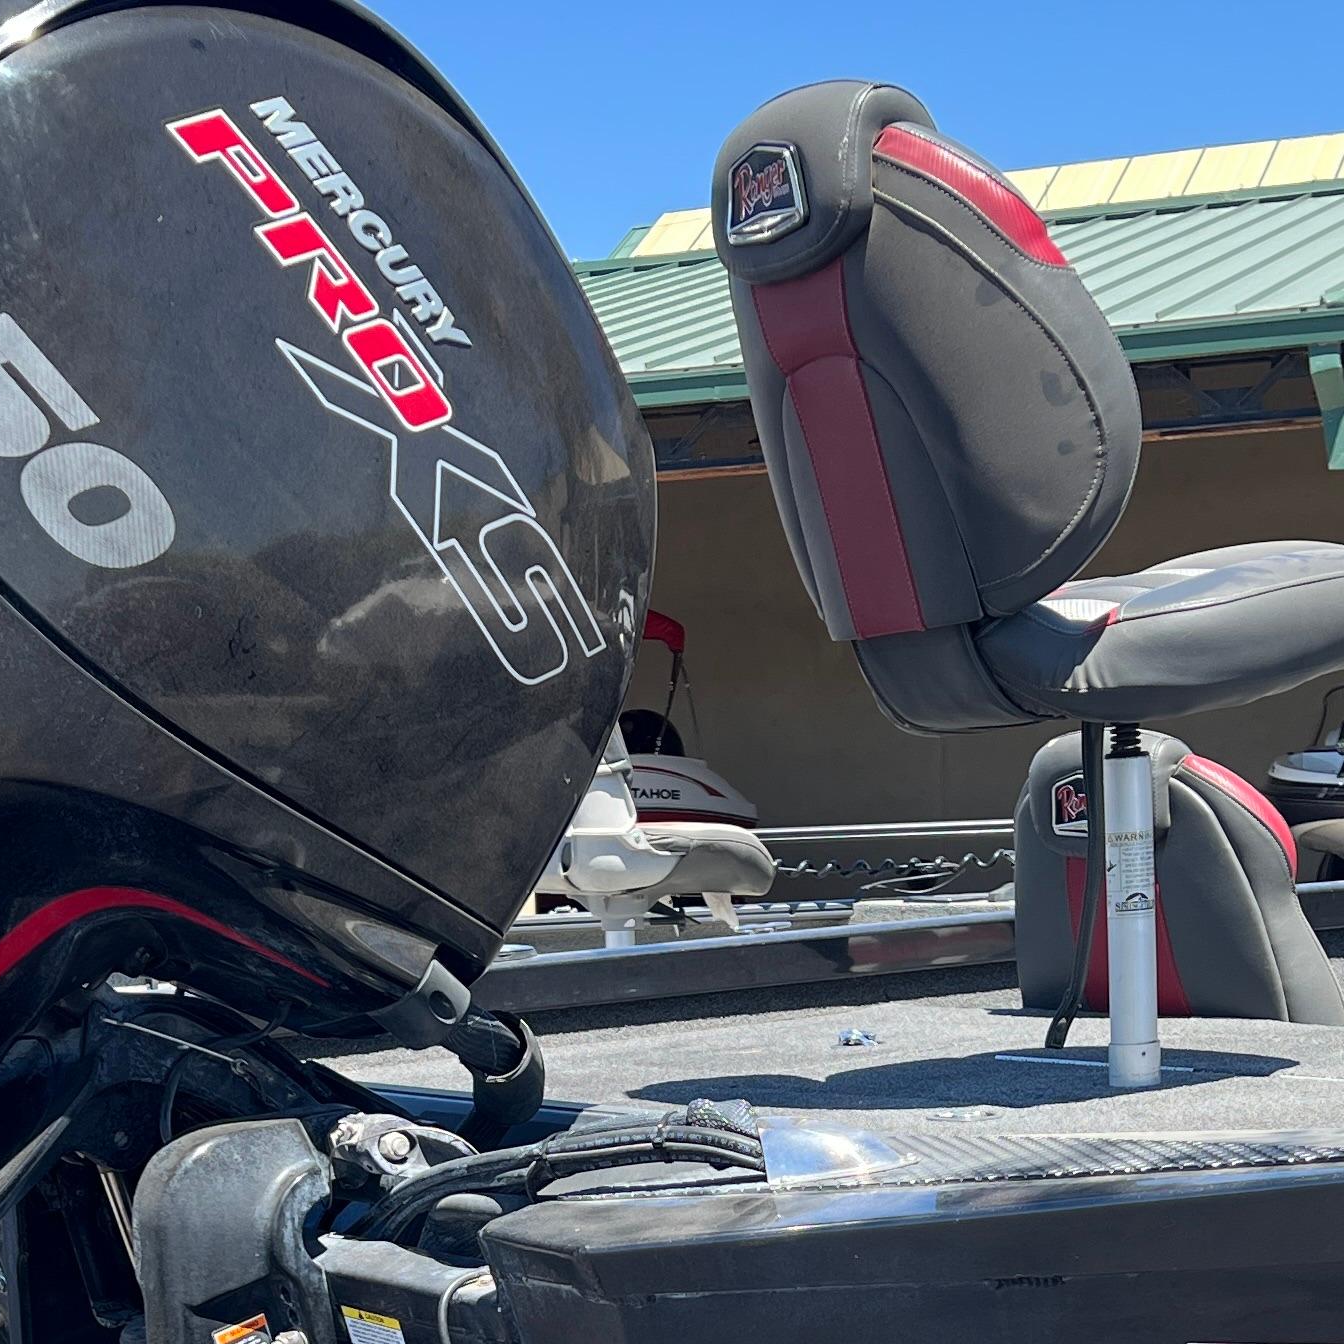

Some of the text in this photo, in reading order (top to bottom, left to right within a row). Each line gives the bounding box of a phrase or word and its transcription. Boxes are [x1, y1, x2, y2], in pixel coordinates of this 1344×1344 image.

[250, 96, 472, 351] MERCURY
[735, 160, 786, 221] Ranger
[165, 108, 452, 432] PRO
[631, 787, 681, 800] TAHOE
